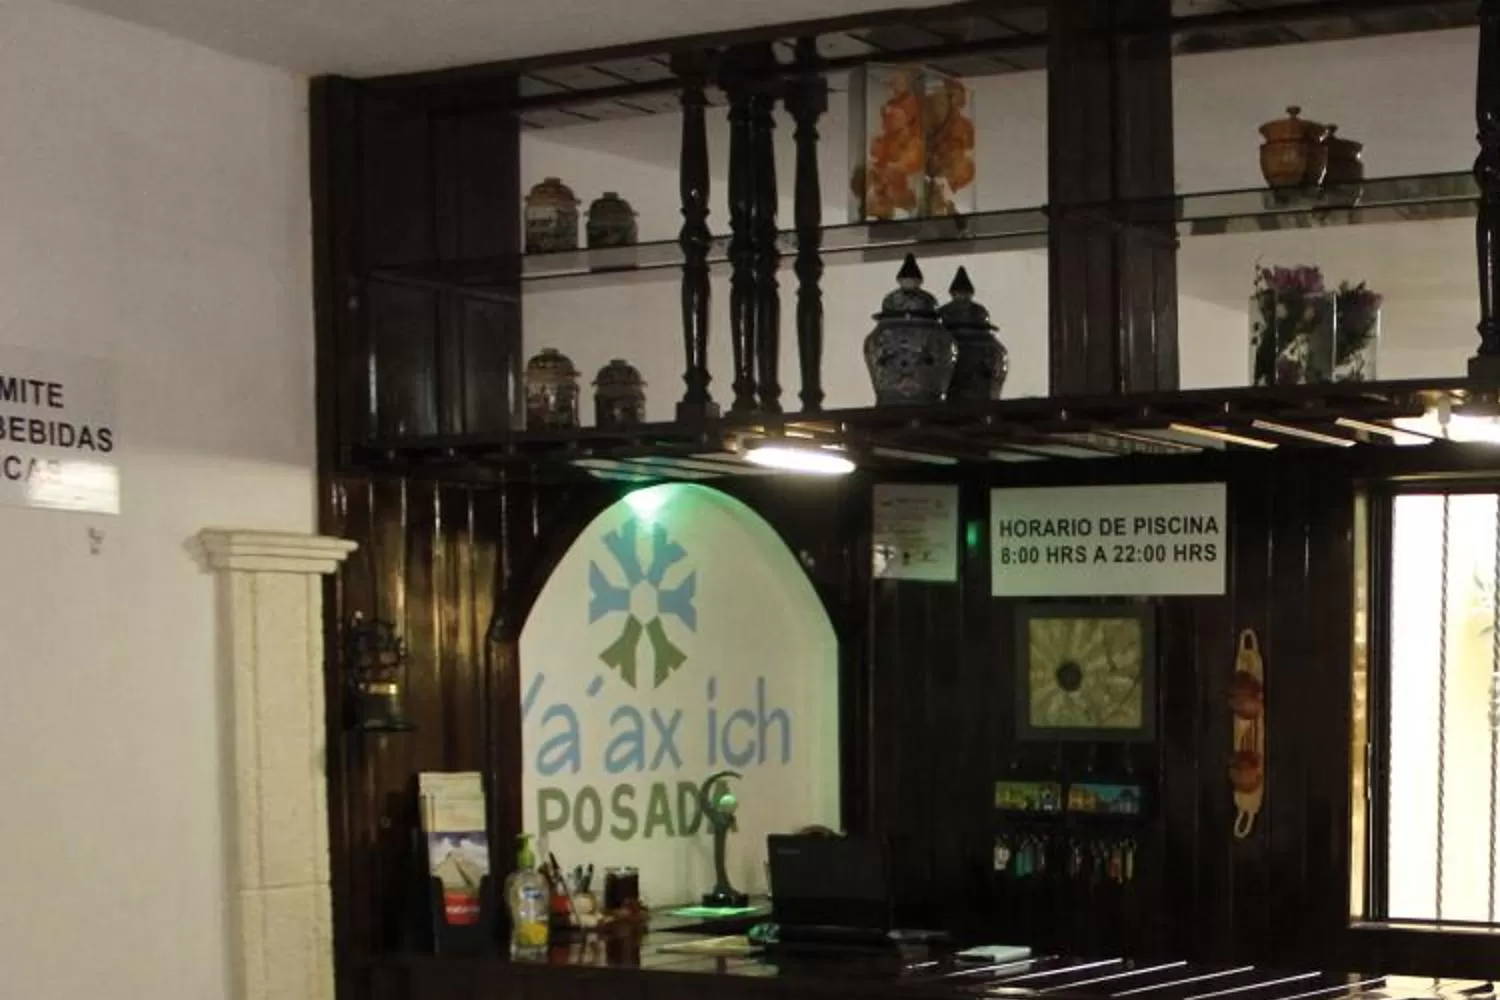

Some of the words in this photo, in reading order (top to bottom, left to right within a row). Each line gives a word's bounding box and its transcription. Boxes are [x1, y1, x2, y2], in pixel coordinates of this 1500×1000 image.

[0, 376, 64, 408] MITE
[1000, 518, 1092, 538] HORARIO
[1098, 517, 1127, 537] DE
[1134, 516, 1219, 535] PISCINA
[1047, 545, 1087, 564] HRS
[1093, 545, 1108, 563] A
[1113, 544, 1166, 563] 22:00
[1173, 543, 1217, 562] HRS
[707, 675, 792, 767] ich
